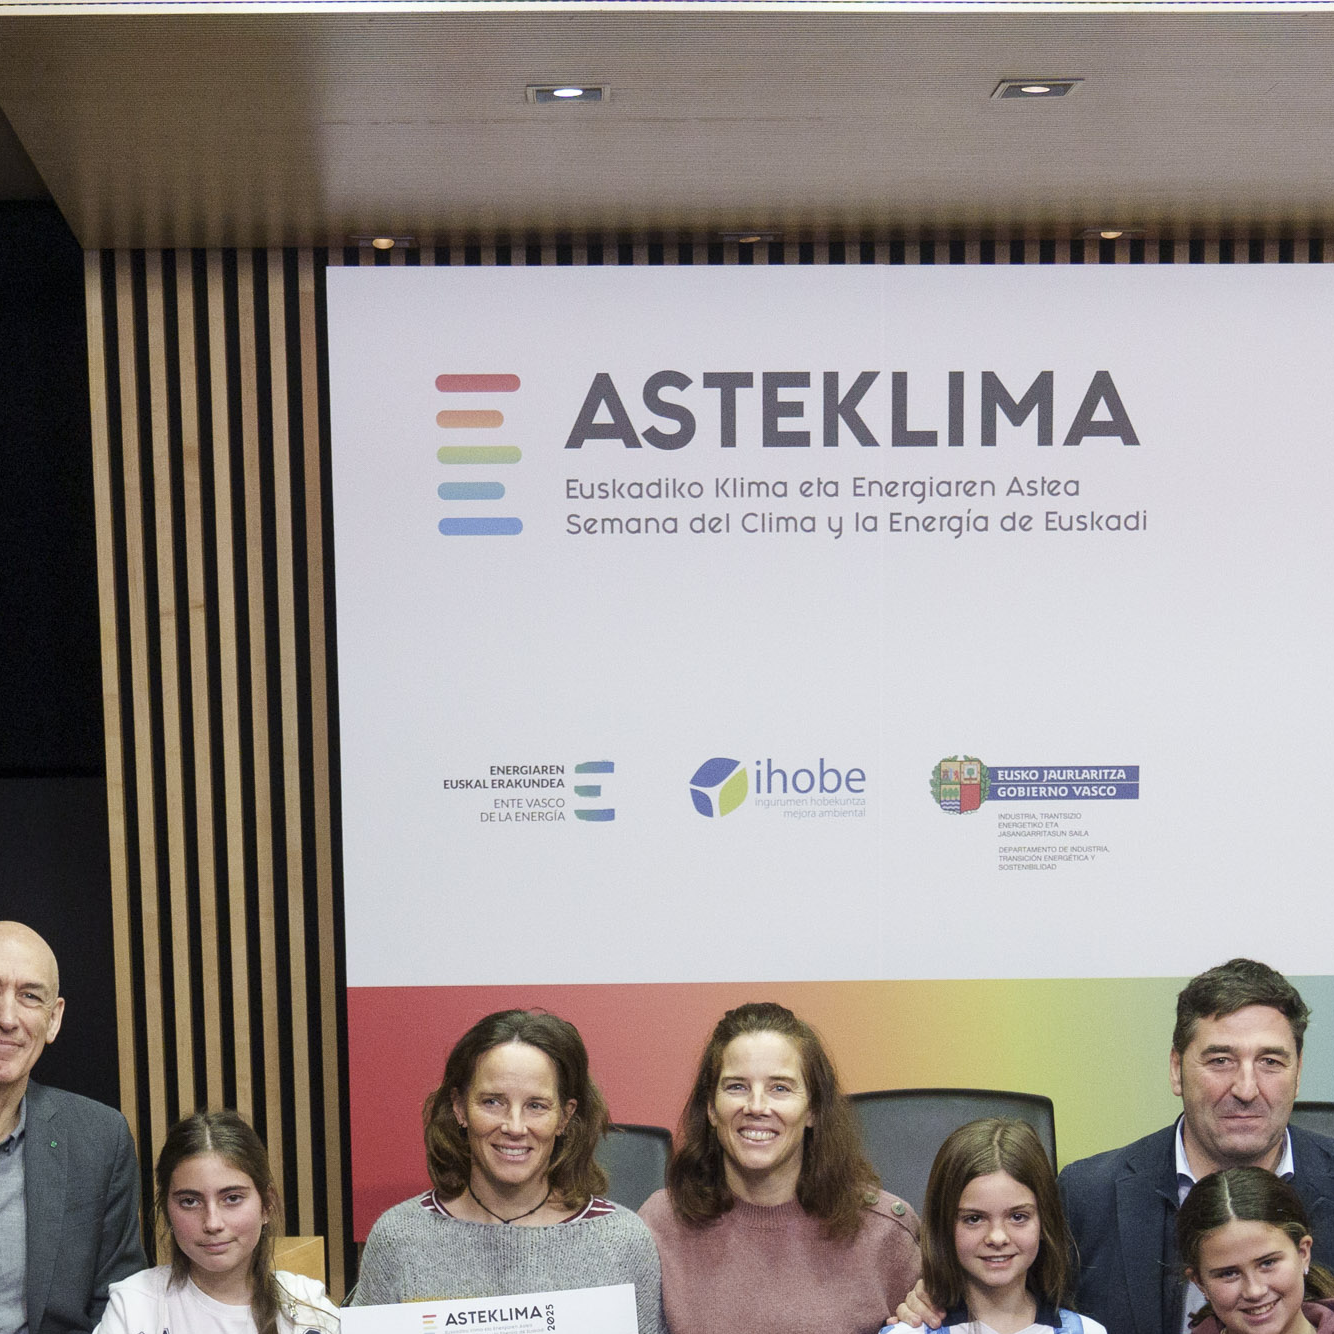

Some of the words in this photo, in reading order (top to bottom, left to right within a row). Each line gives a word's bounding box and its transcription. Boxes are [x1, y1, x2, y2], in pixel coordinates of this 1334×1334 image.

[564, 370, 1142, 451] ASTEKLIMA
[565, 477, 705, 499] Euskadiko
[714, 476, 789, 498] Klima
[799, 477, 841, 498] eta
[852, 475, 997, 503] Energiaren
[1005, 475, 1081, 498] Astea
[565, 513, 679, 535] Semana
[689, 511, 731, 534] del
[740, 511, 817, 534] Clima
[827, 517, 845, 539] y
[854, 510, 879, 534] la
[888, 508, 990, 539] Energía
[998, 509, 1034, 533] de
[1044, 508, 1148, 533] Euskadi
[489, 765, 565, 776] ENERGIAREN
[755, 758, 866, 794] ihobe
[997, 770, 1039, 781] EUSKO
[1042, 769, 1127, 782] JAURLARITZA
[443, 779, 489, 790] EUSKAL
[491, 778, 565, 789] ERAKUNDEA
[997, 786, 1069, 798] GOBIERNO
[1072, 786, 1117, 797] VASCO
[494, 798, 522, 809] ENTE
[523, 797, 566, 808] VASCO
[754, 797, 808, 809] ingurumen
[810, 797, 866, 807] hobekuntza
[480, 811, 496, 823] DE
[498, 811, 513, 822] LA
[514, 808, 566, 822] ENERGÍA
[783, 810, 816, 821] mejora
[818, 808, 866, 818] ambiental
[445, 1305, 543, 1327] ASTEKLIMA
[545, 1303, 556, 1331] 2025
